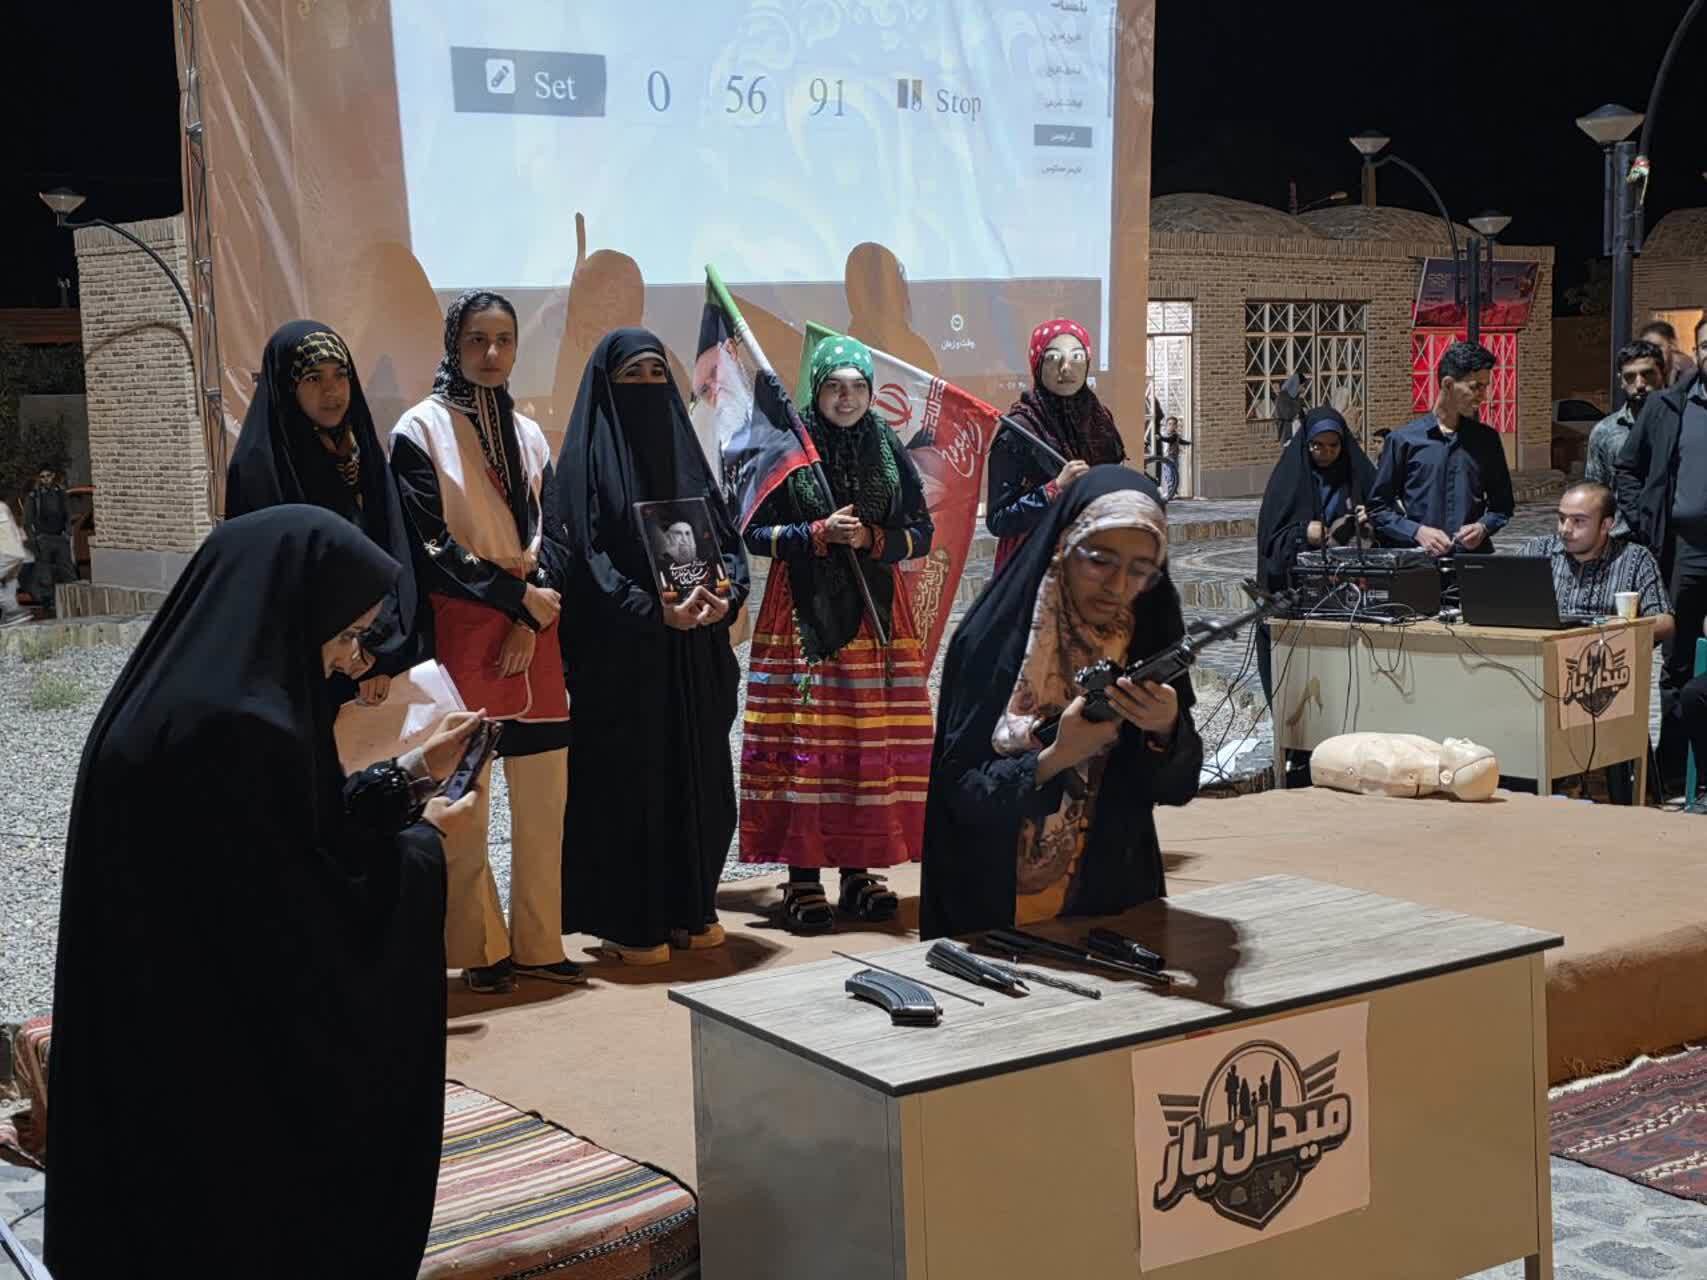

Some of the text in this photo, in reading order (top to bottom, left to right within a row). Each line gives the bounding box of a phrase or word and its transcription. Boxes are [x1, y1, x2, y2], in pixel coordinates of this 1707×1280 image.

[534, 71, 577, 100] Set
[648, 69, 845, 117] 0 56 91
[936, 88, 982, 122] Stop
[1157, 1096, 1349, 1201] میدان یار
